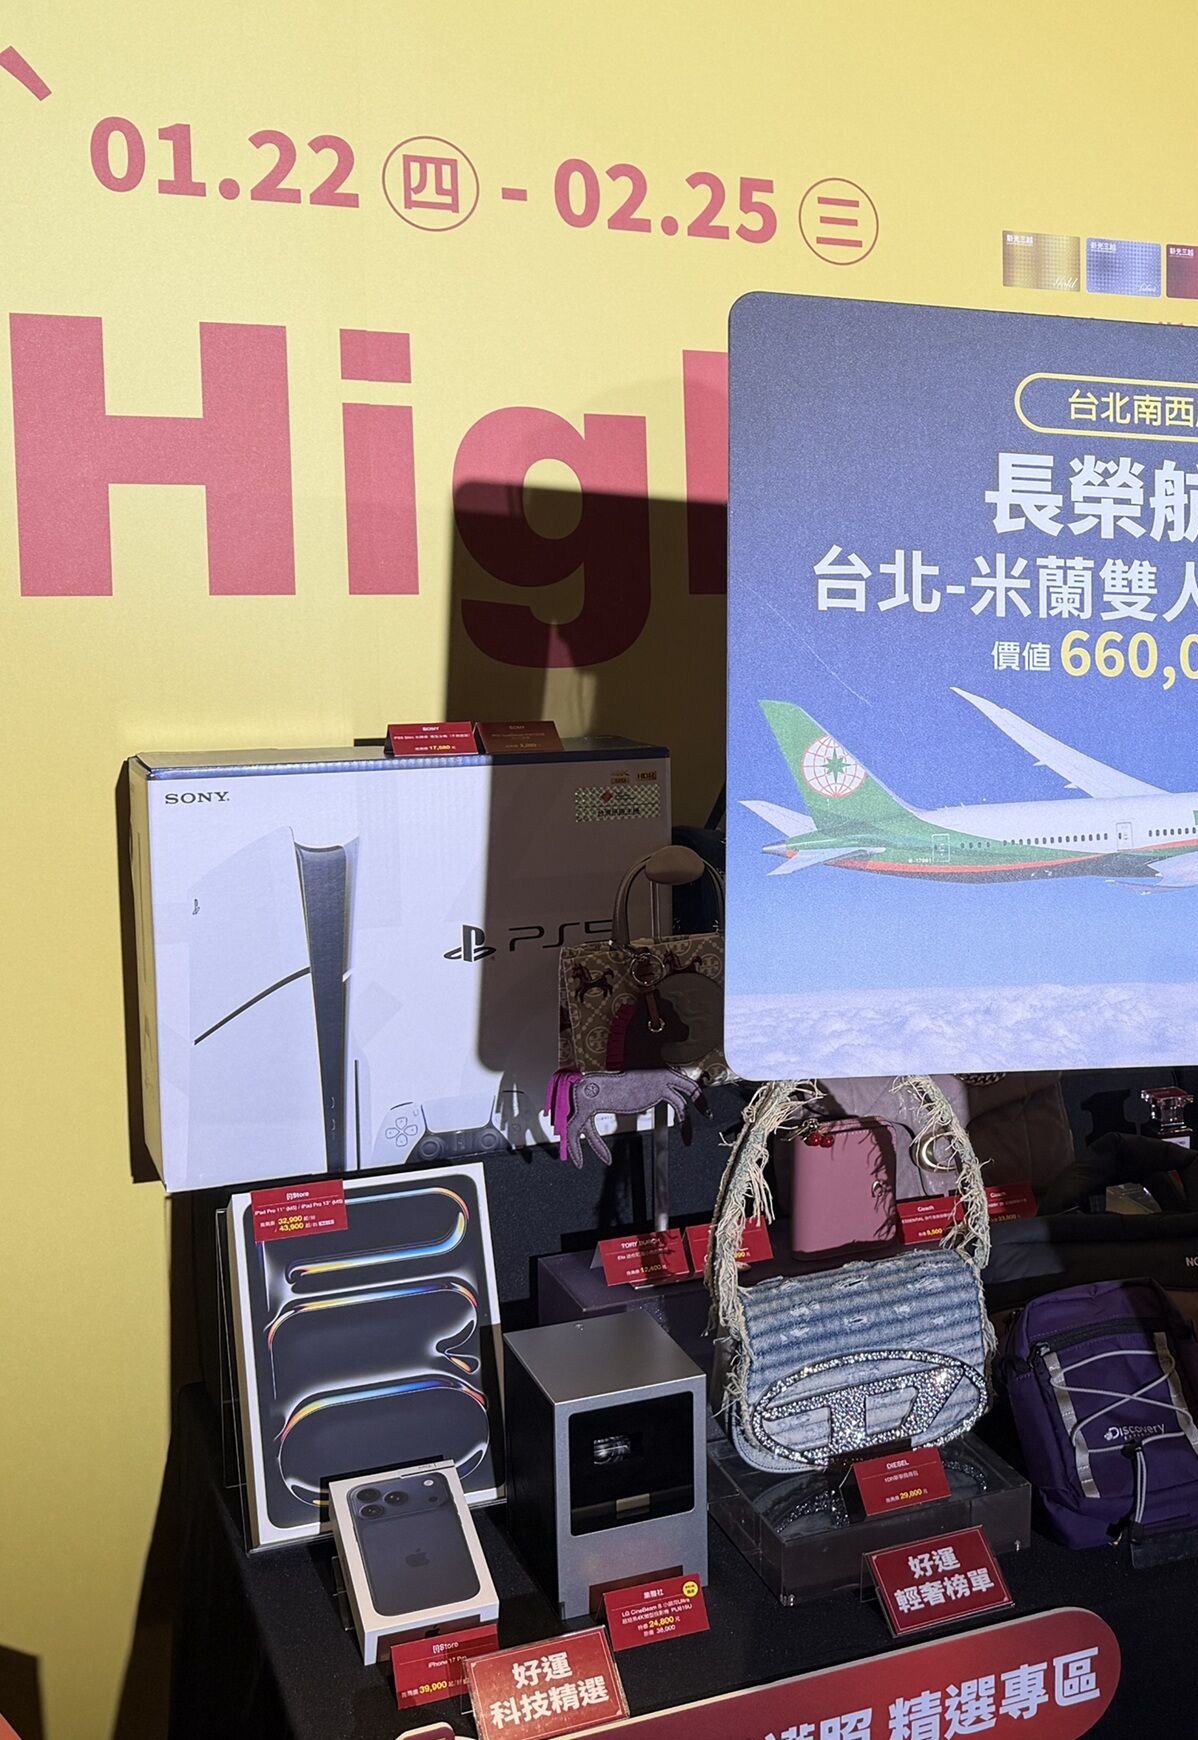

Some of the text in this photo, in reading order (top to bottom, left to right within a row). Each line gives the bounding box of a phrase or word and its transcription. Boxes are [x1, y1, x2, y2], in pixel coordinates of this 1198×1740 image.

[89, 116, 360, 209] 01.22
[553, 158, 778, 245] 02.25
[990, 640, 1051, 673] 價值
[165, 791, 229, 805] SONY
[508, 919, 613, 952] PS5
[620, 1241, 638, 1249] TORY
[886, 1459, 910, 1470] DIESEL
[908, 1546, 961, 1579] 好運
[893, 1567, 995, 1613] 輕奢榜單
[648, 1615, 675, 1628] 24,800
[428, 1659, 448, 1669] iPhone
[511, 1651, 573, 1689] 好運
[419, 1681, 448, 1695] 39,900
[489, 1675, 609, 1730] 科技精選
[888, 1646, 1101, 1740] 精選專區
